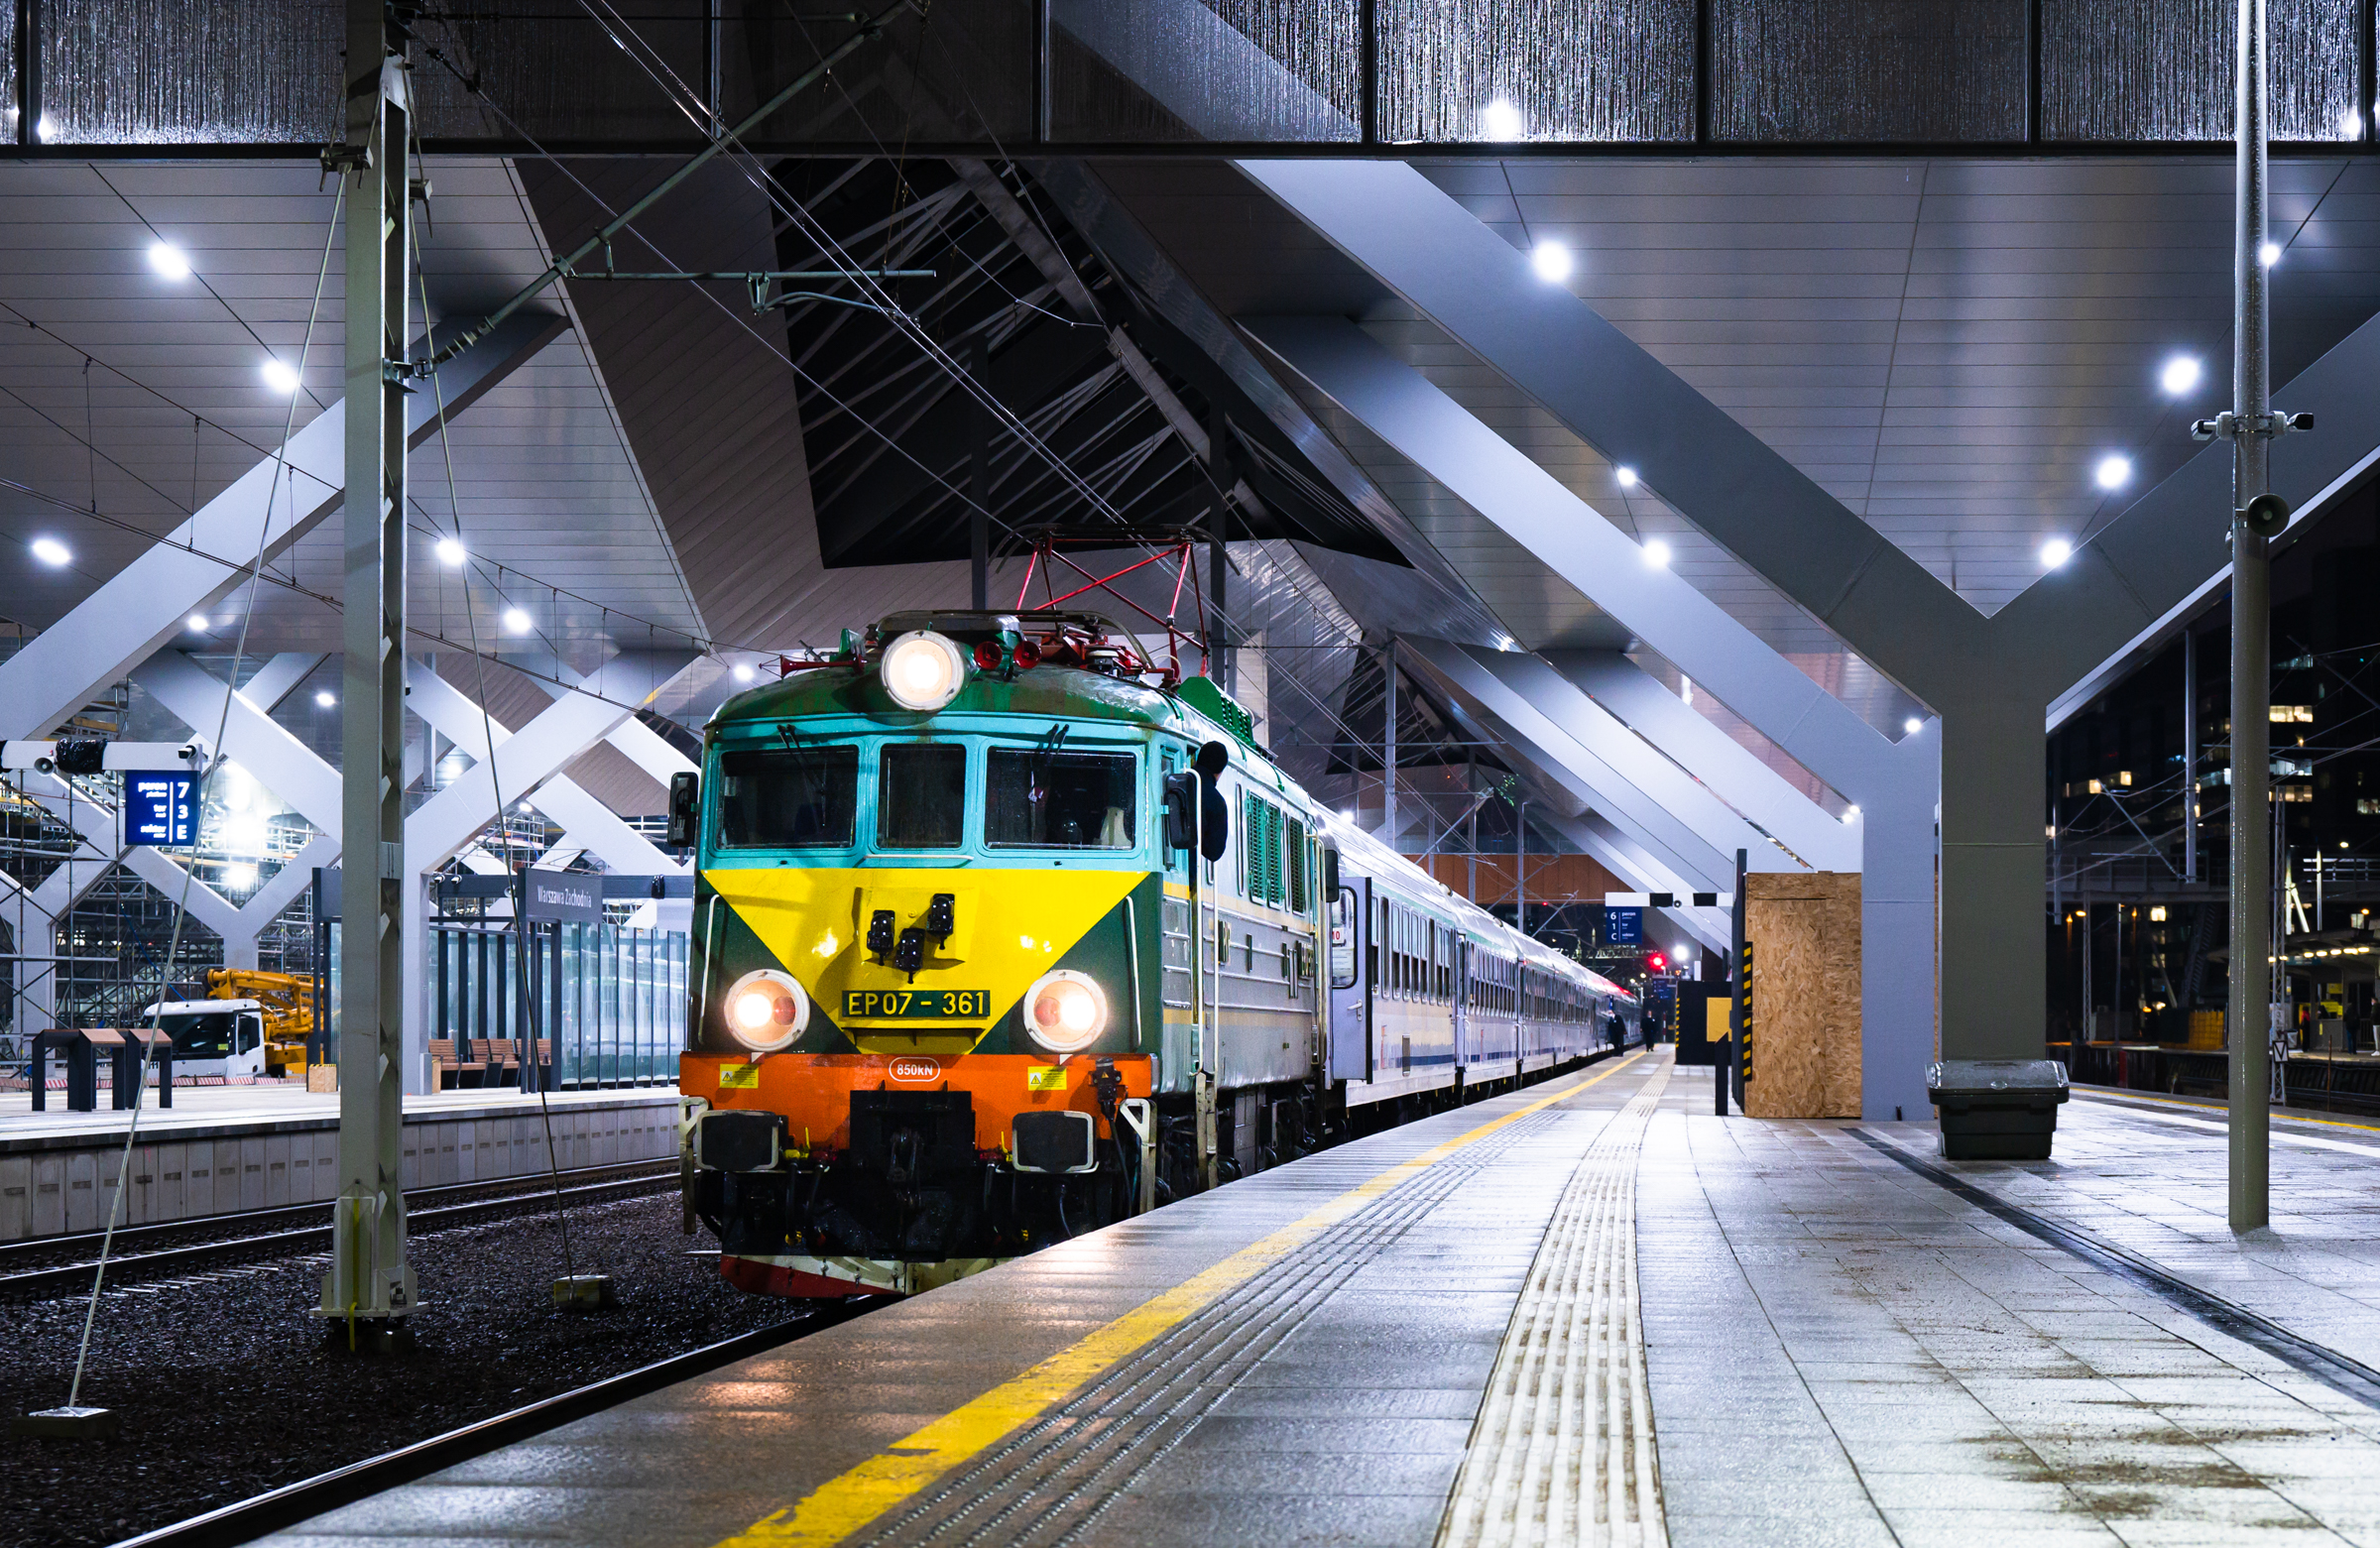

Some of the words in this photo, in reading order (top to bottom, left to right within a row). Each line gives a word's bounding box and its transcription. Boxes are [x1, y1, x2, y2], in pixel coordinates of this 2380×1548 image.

[178, 782, 190, 798] 7
[178, 804, 188, 819] 3
[177, 825, 187, 839] E
[537, 885, 564, 904] Warszawa
[564, 888, 592, 908] Zachodnia
[1610, 912, 1616, 920] 6
[848, 993, 913, 1015] EP07
[942, 992, 984, 1014] 361
[896, 1063, 933, 1076] 850kN
